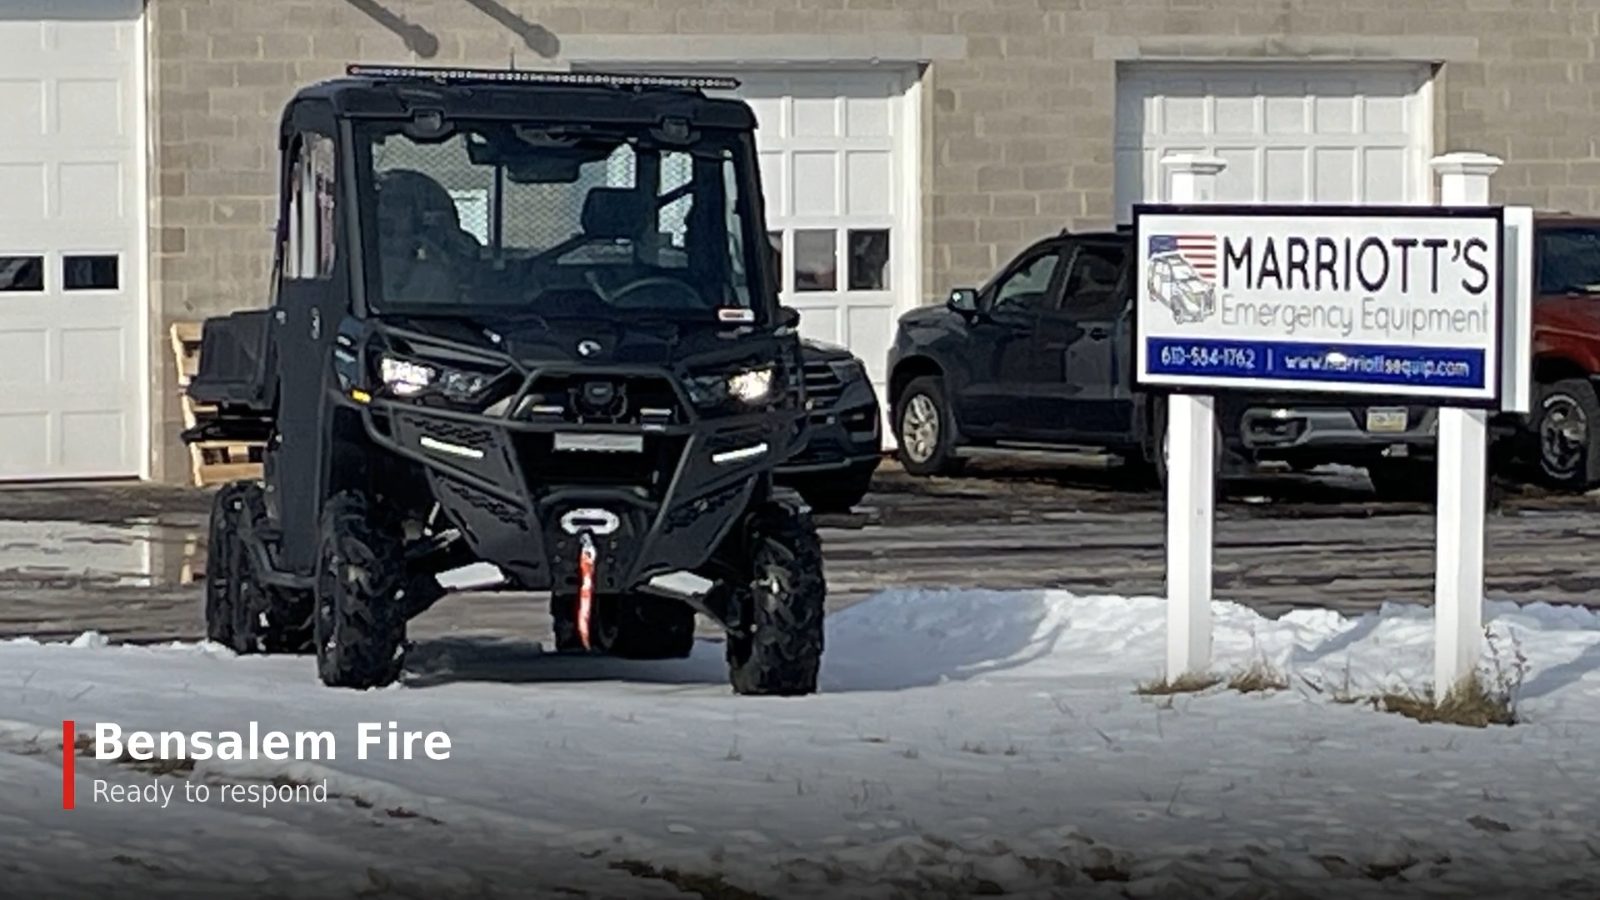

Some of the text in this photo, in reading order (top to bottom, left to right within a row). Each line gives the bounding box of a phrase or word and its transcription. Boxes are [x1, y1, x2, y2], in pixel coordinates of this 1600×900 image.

[1222, 235, 1490, 294] MARRIOTT'S
[1221, 294, 1488, 336] Emergency Equipment
